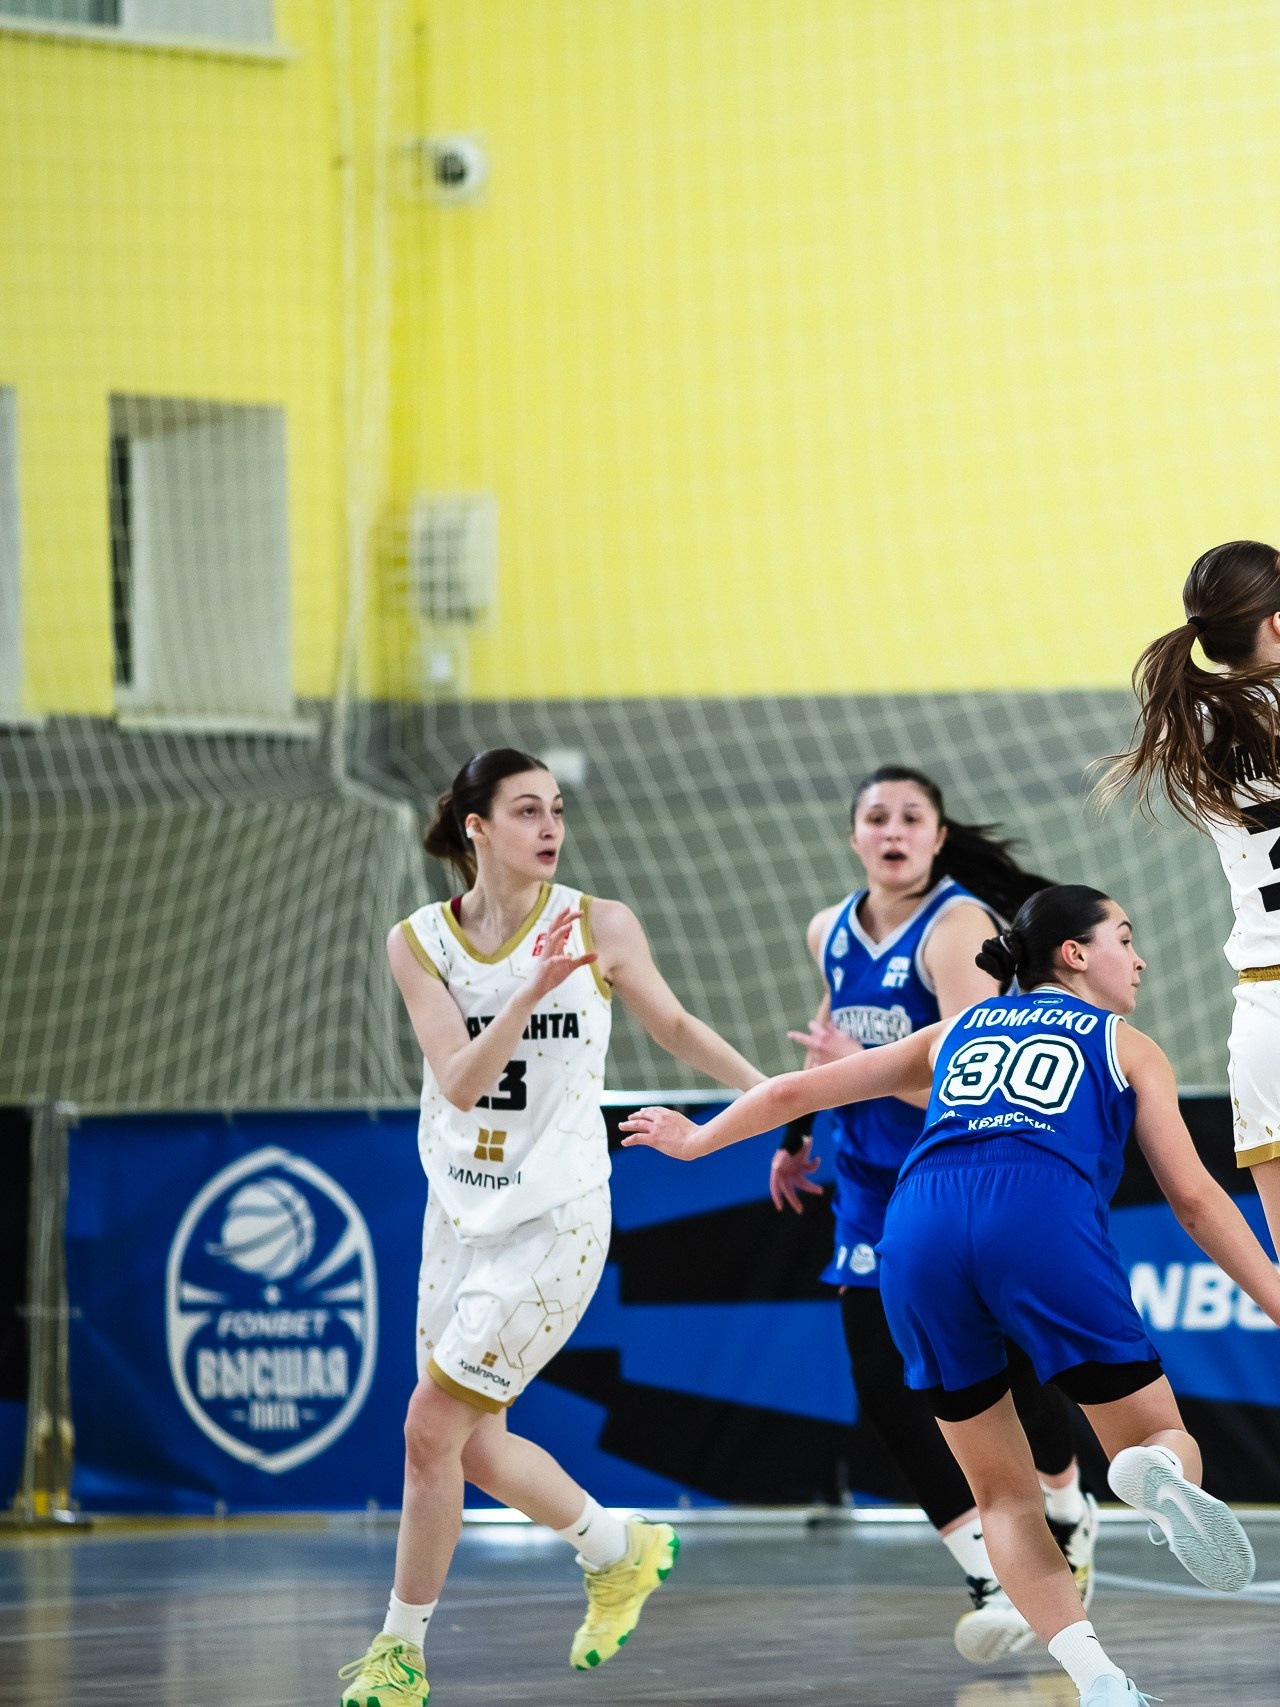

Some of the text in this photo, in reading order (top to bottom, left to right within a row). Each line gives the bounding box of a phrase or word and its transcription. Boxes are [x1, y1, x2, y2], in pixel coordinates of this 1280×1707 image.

[467, 1013, 579, 1041] АТНТА
[964, 1007, 1098, 1035] ЛОМАСКО
[475, 1060, 527, 1110] 3
[938, 1034, 1085, 1115] 30
[217, 1309, 329, 1339] FONBET
[196, 1346, 349, 1400] ВЫСШАЯ
